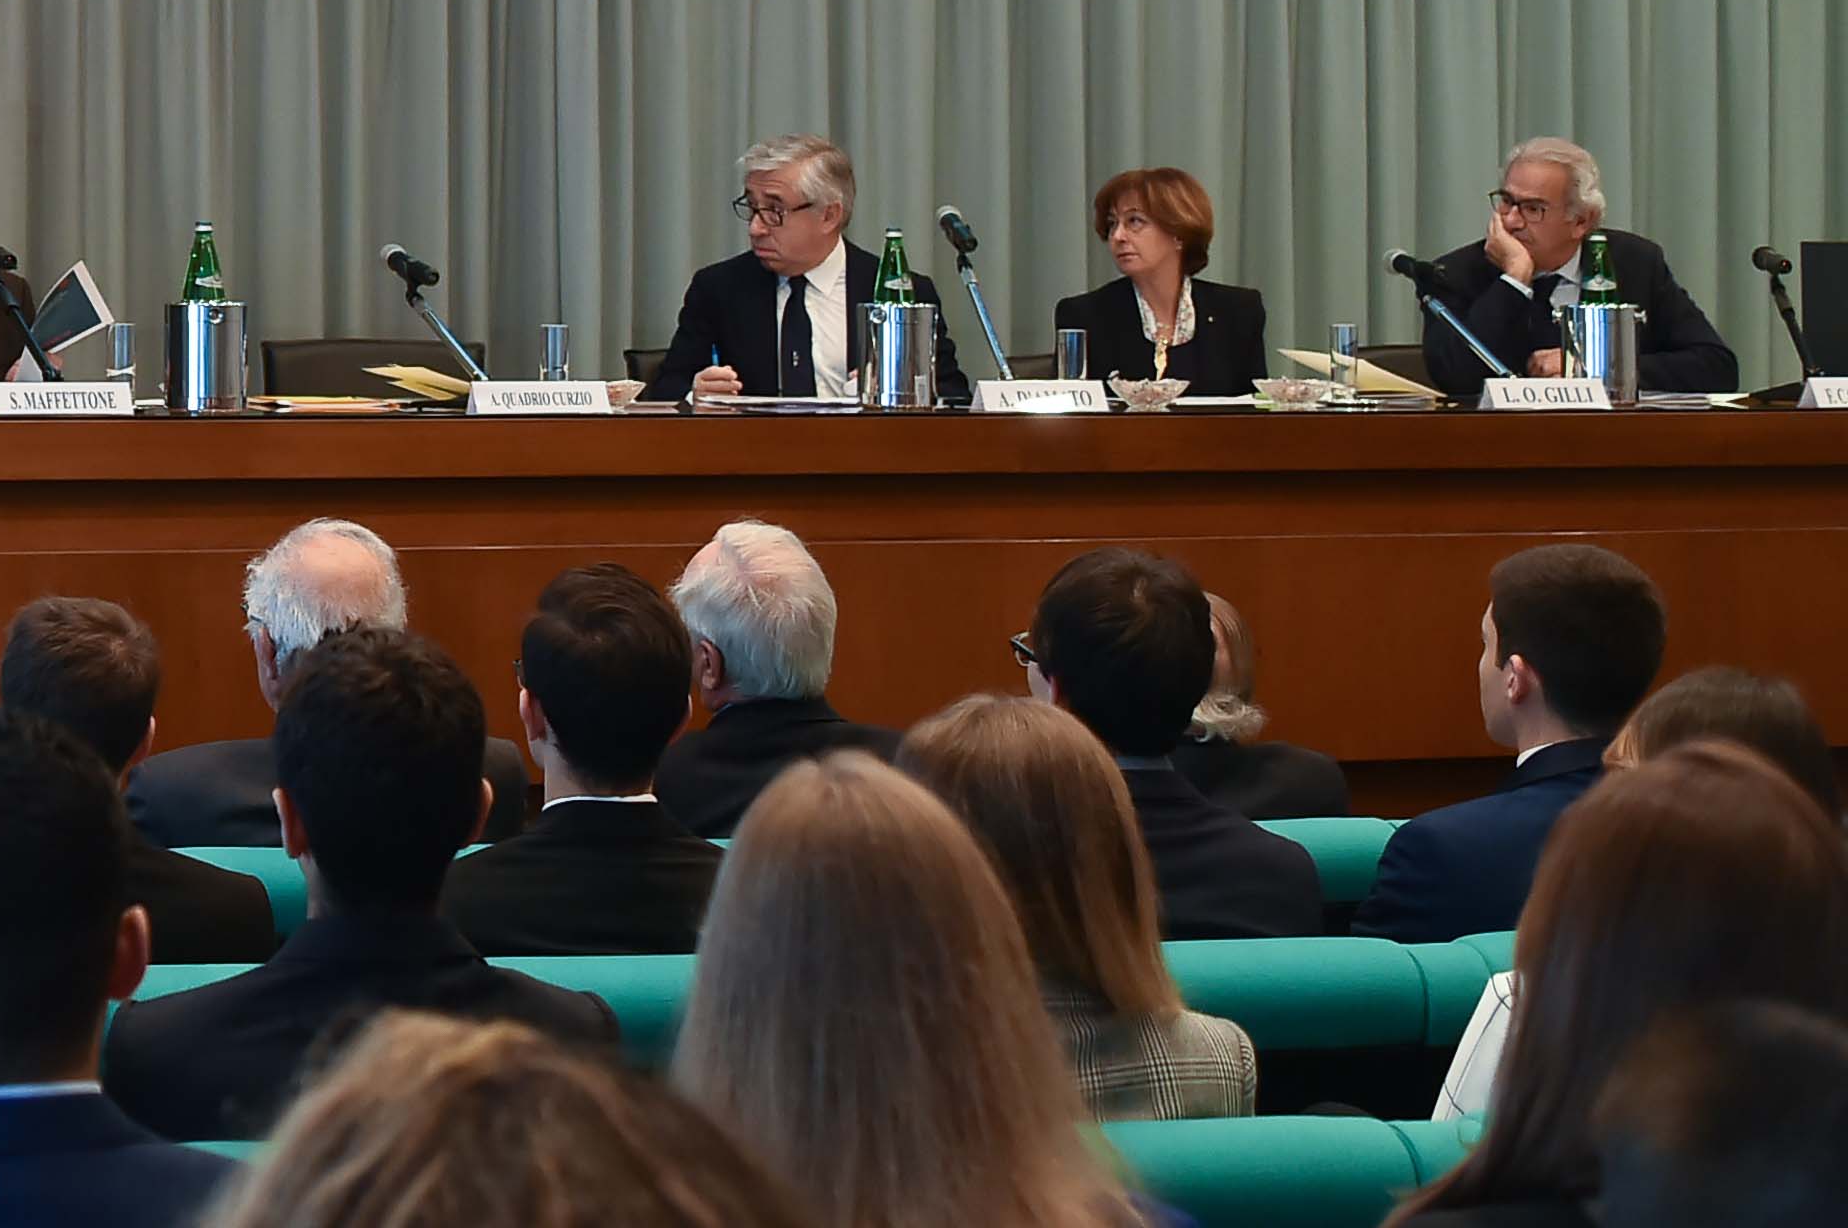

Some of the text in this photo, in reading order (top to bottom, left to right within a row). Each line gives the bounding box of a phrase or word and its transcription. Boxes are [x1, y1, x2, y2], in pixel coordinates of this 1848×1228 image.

[9, 391, 117, 410] S. MAFFETTONE
[490, 390, 592, 409] A. QUADRIO CURZIO
[1000, 390, 1015, 408] A.
[1503, 387, 1593, 403] L. O. GILLI
